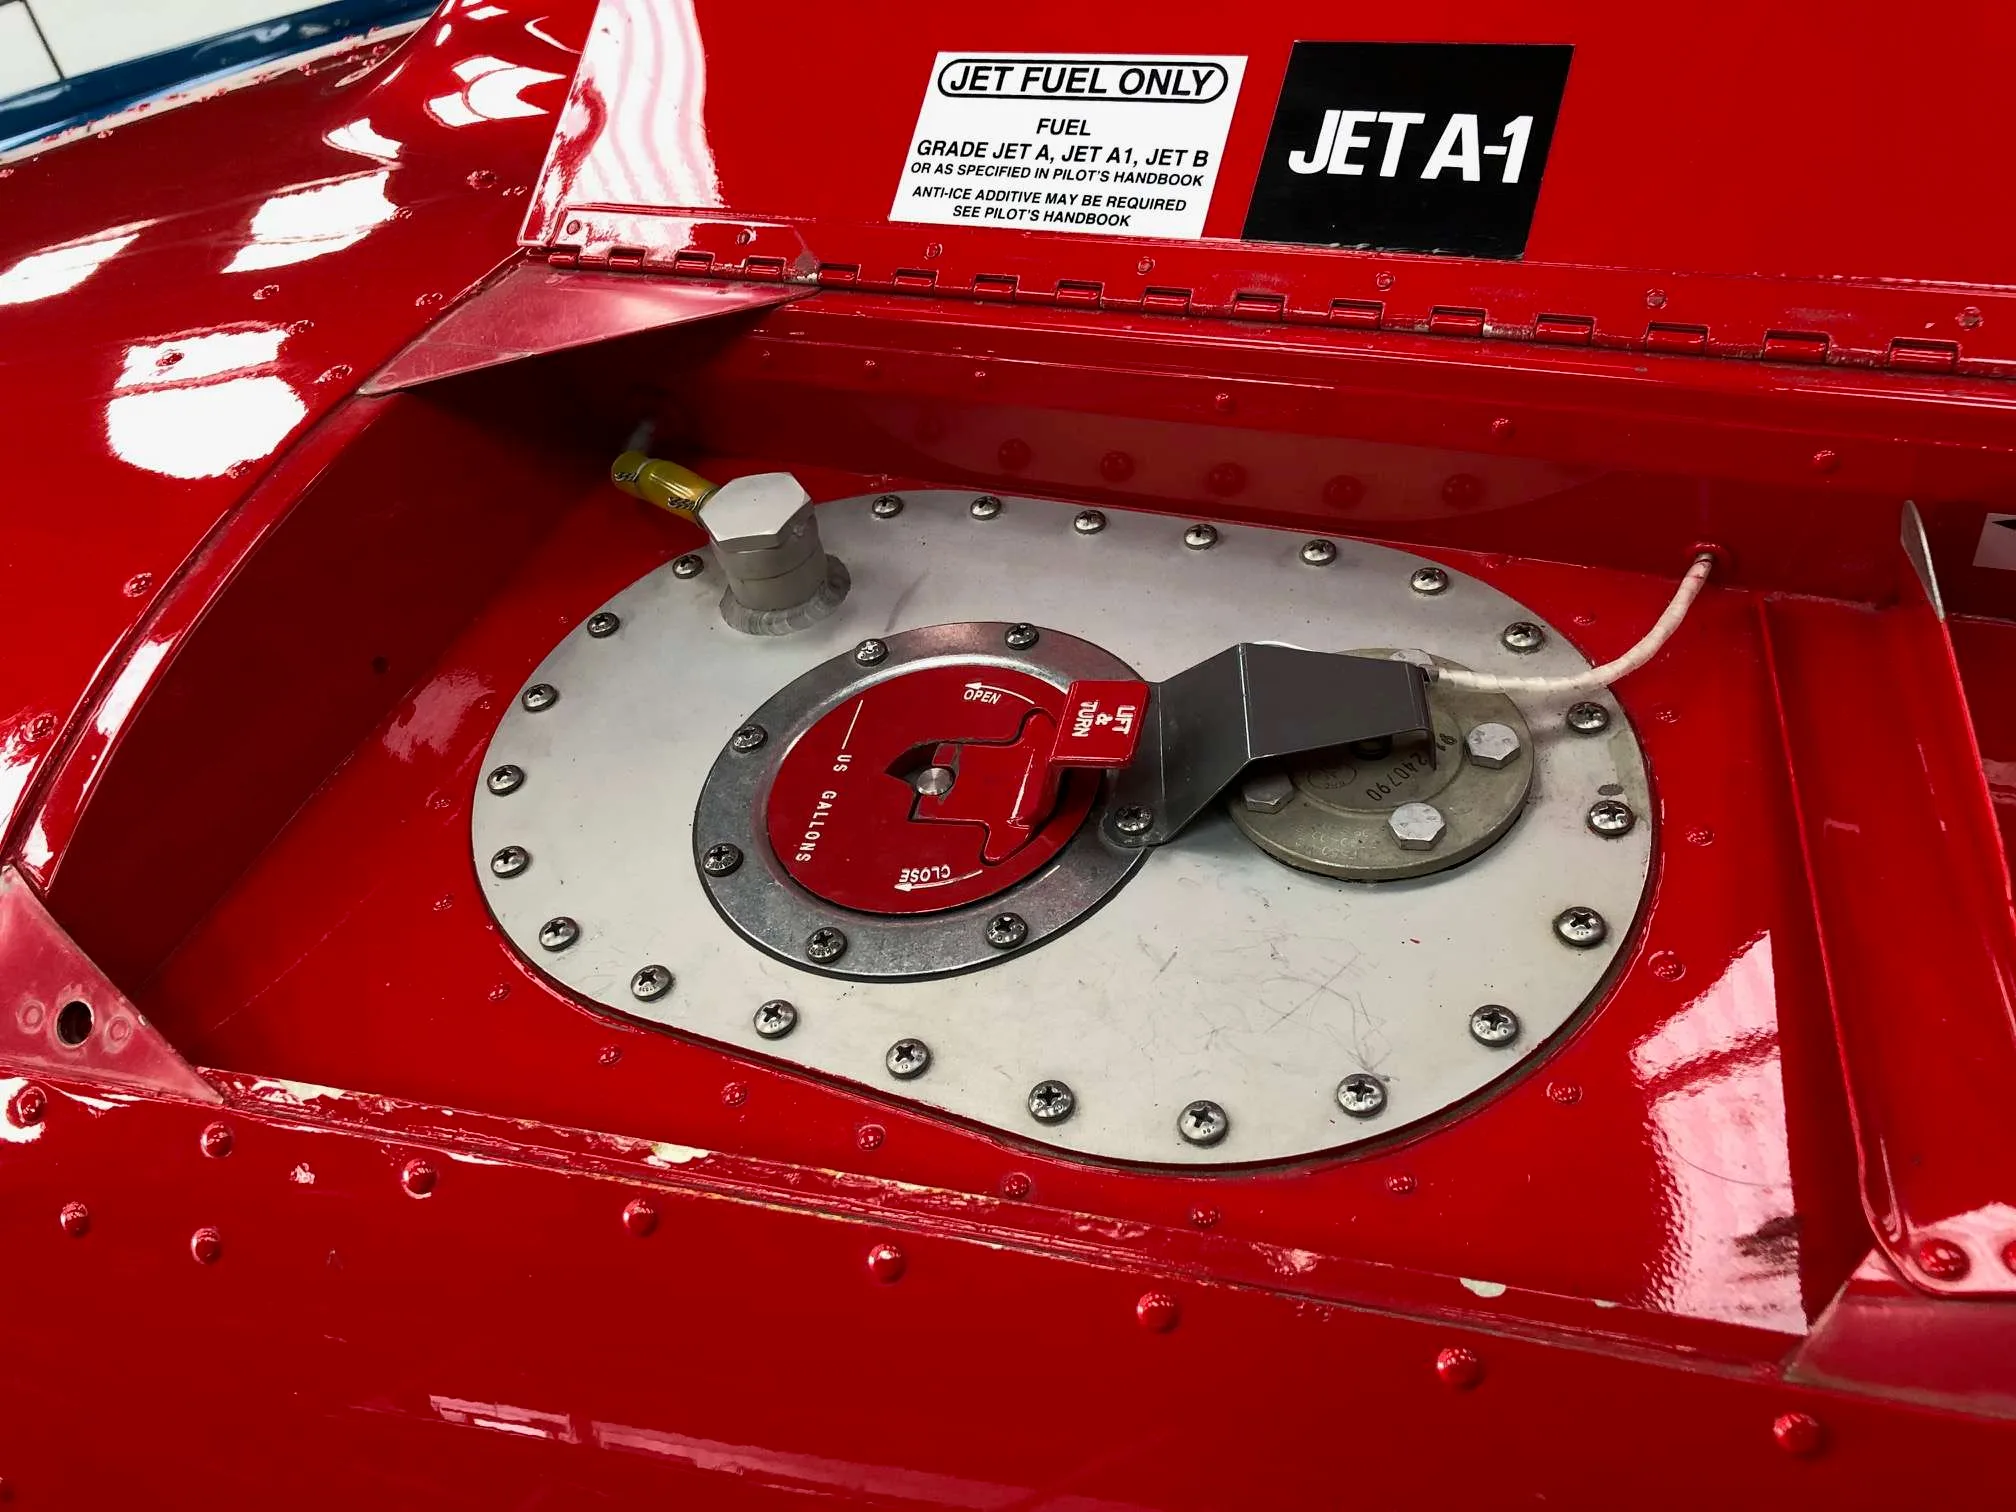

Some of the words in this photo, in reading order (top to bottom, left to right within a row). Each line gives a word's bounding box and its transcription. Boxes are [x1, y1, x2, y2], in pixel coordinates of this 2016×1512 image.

[950, 66, 1015, 91] JET
[1020, 67, 1107, 94] FUEL
[1119, 68, 1215, 96] ONLY
[1036, 118, 1091, 136] FUEL
[918, 140, 989, 158] GRADE
[993, 143, 1032, 159] JET
[1062, 146, 1103, 162] JET
[1106, 147, 1138, 168] A1,
[1146, 149, 1189, 166] JET
[1193, 150, 1209, 167] B
[1288, 109, 1426, 177] JET
[1420, 113, 1534, 184] A-1
[911, 162, 931, 173] OR
[934, 164, 954, 175] AS
[958, 164, 1031, 178] SPECIFIED
[1034, 168, 1050, 179] IN
[1053, 168, 1110, 182] PILOT'S
[1114, 172, 1204, 187] HANDBOOK
[912, 186, 972, 200] ANTI-ICE
[975, 190, 1042, 204] ADDITIVE
[1045, 193, 1078, 205] MAY
[1082, 195, 1103, 207] BE
[1106, 196, 1187, 211] REQUIRED
[953, 206, 981, 218] SEE
[985, 207, 1040, 221] PILOT'S
[1044, 211, 1131, 227] HANDBOOK
[963, 689, 1002, 705] OPEN
[1071, 699, 1099, 738] TURN
[1094, 711, 1114, 726] &
[1111, 704, 1136, 735] LIFT
[832, 754, 852, 773] US
[1366, 752, 1428, 802] 240790
[795, 790, 838, 862] GALLONS
[898, 864, 951, 883] CLOSE
